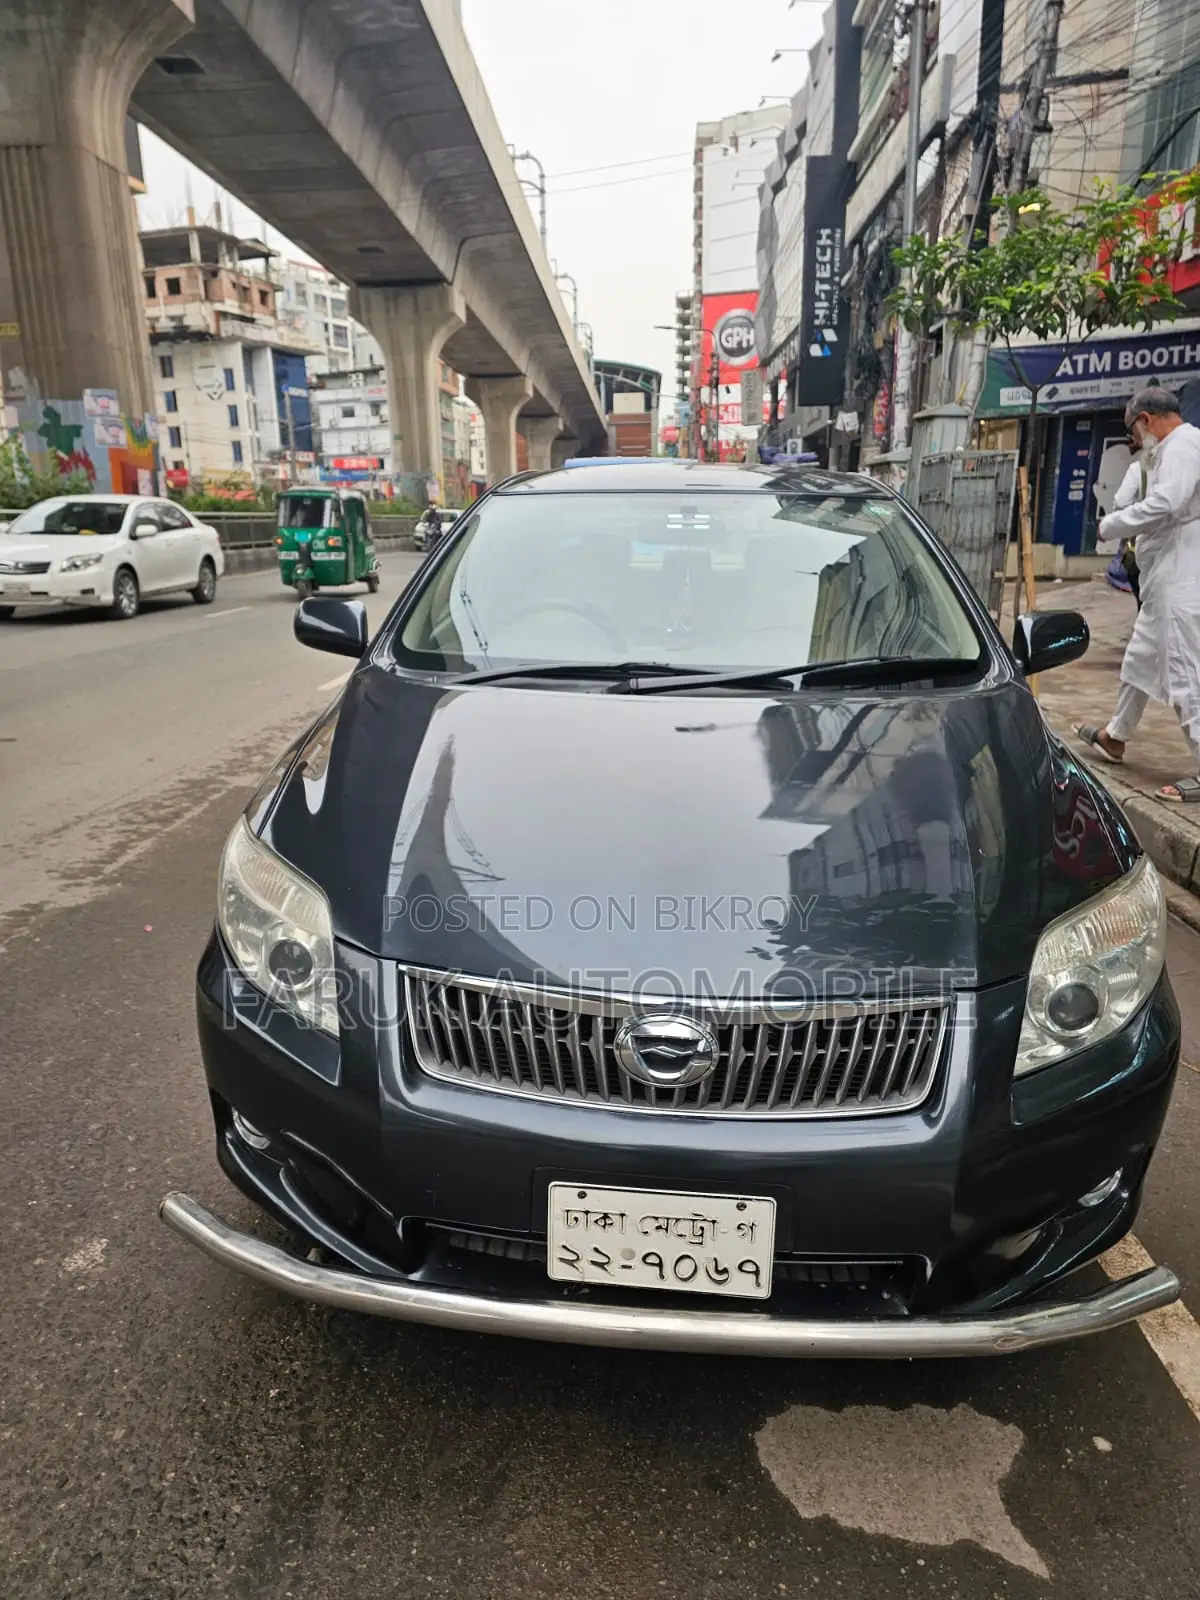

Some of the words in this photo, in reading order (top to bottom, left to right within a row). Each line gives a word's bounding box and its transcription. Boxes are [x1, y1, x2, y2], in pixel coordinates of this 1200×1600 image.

[813, 228, 834, 325] HI-TECH
[720, 327, 755, 348] GPH
[1055, 351, 1112, 376] ATM
[1118, 346, 1200, 370] BOOTH
[562, 1208, 626, 1233] ঢাকা
[557, 1243, 762, 1288] ২২-৭০৬৭
